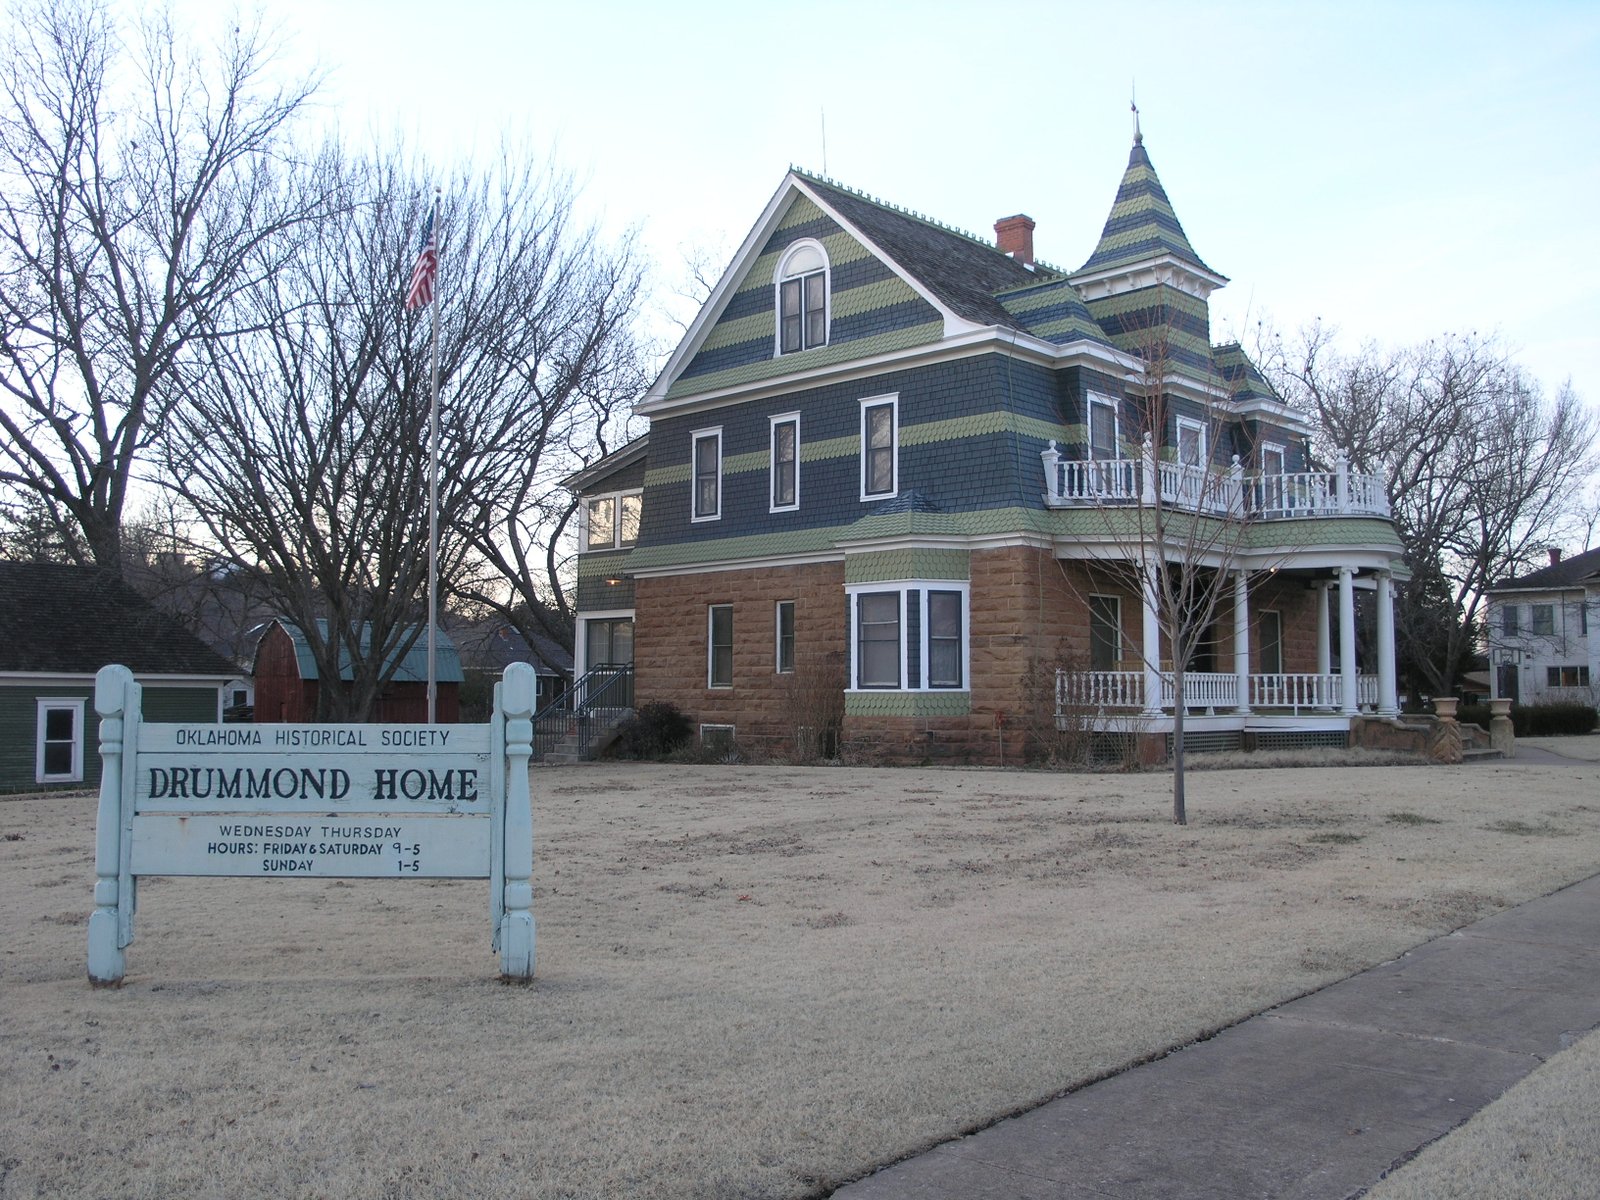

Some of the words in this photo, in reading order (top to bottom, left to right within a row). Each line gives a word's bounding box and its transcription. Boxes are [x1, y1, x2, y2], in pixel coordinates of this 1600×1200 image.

[176, 729, 262, 746] OKLAHOMA
[275, 730, 368, 746] HISTORICAL
[381, 730, 450, 746] SOCIETY
[148, 767, 351, 800] DRUMMOND
[373, 768, 478, 800] HOME
[219, 825, 312, 838] WEDNESDAY
[320, 826, 402, 839] THURSDAY
[207, 842, 258, 854] HOURS:
[392, 842, 421, 856] 9-5
[262, 859, 314, 872] SUNDAY
[397, 860, 420, 872] 1-5
